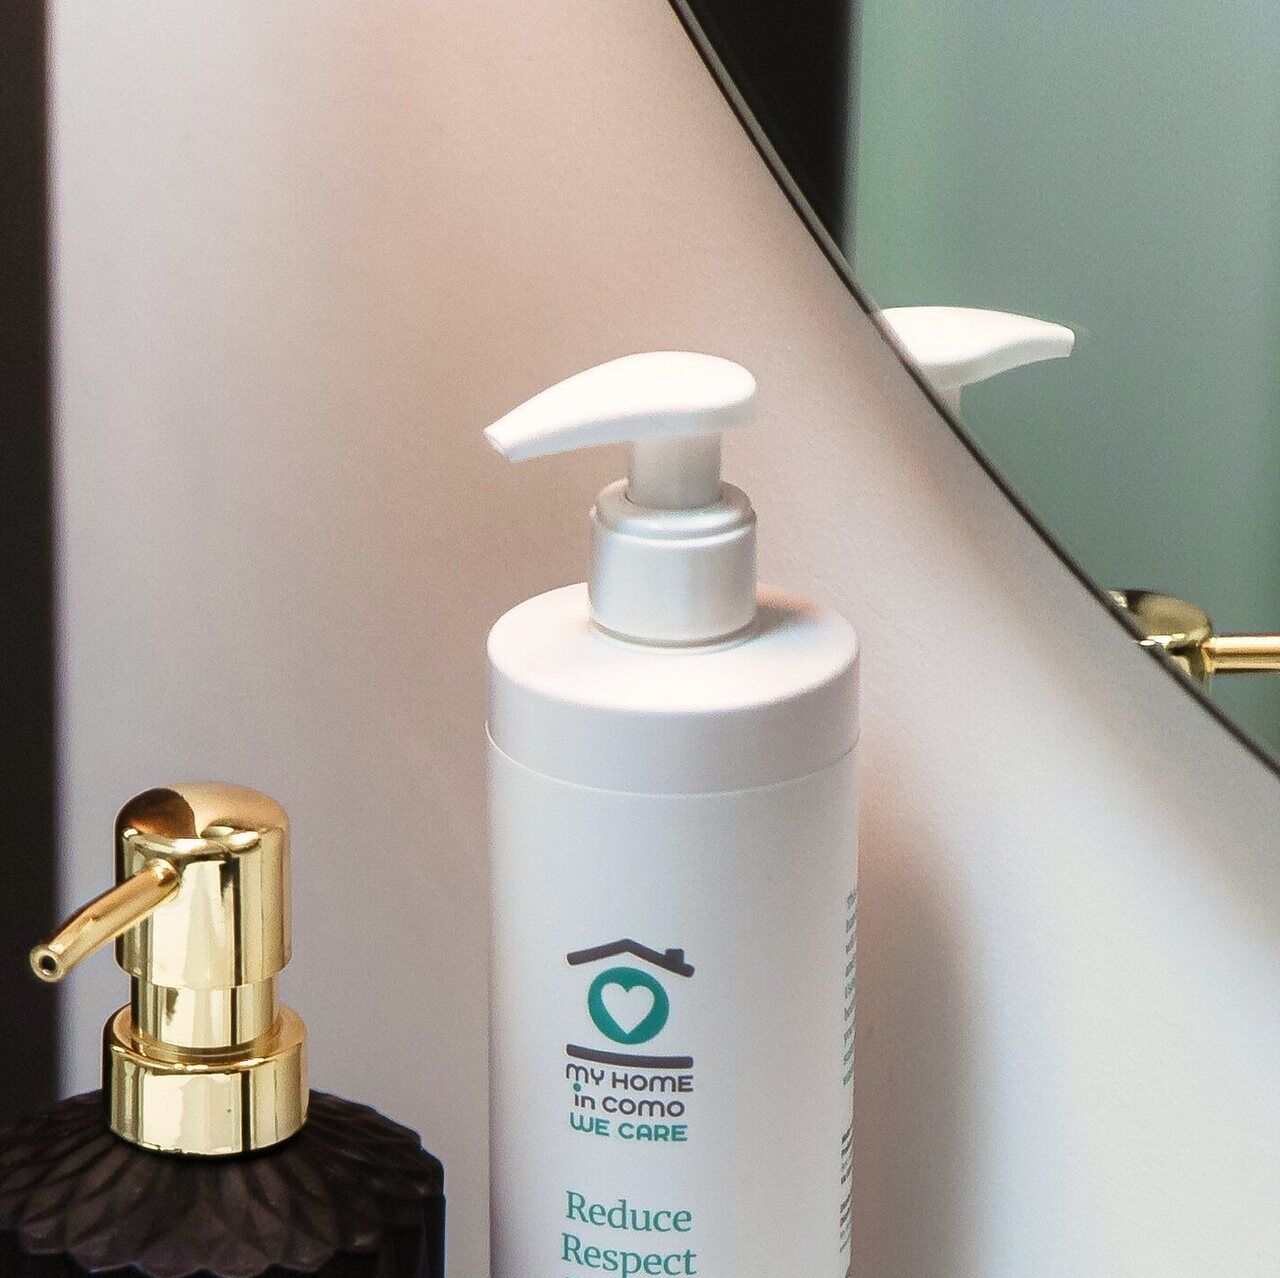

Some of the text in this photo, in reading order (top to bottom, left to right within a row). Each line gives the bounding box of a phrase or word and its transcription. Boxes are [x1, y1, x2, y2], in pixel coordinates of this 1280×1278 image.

[566, 1063, 694, 1093] MY HOME
[573, 1083, 596, 1110] in
[570, 1112, 688, 1142] WE CARE
[566, 1190, 693, 1233] Reduce
